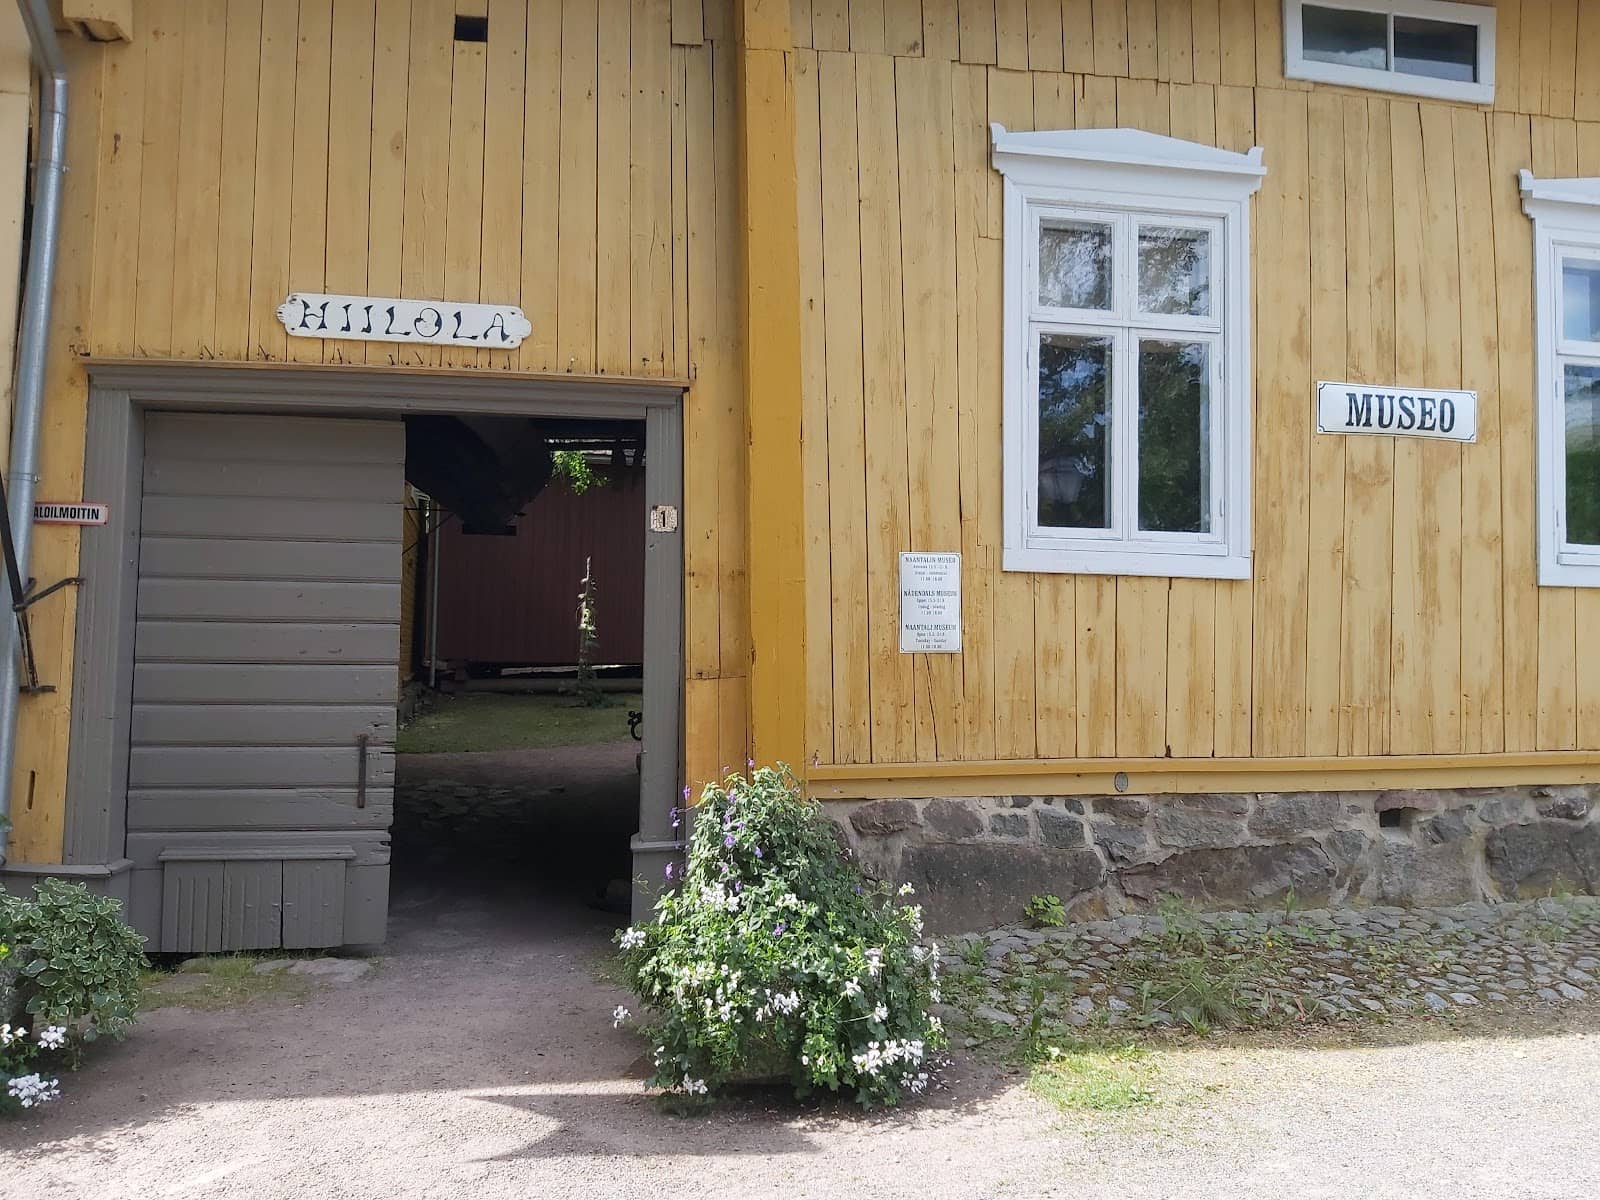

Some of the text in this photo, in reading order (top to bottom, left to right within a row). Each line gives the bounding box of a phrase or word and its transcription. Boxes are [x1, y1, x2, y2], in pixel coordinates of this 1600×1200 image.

[299, 300, 510, 342] HIILOLA
[1345, 393, 1455, 433] MUSEO
[33, 506, 100, 520] ALOILMOITIN
[660, 510, 666, 528] 1
